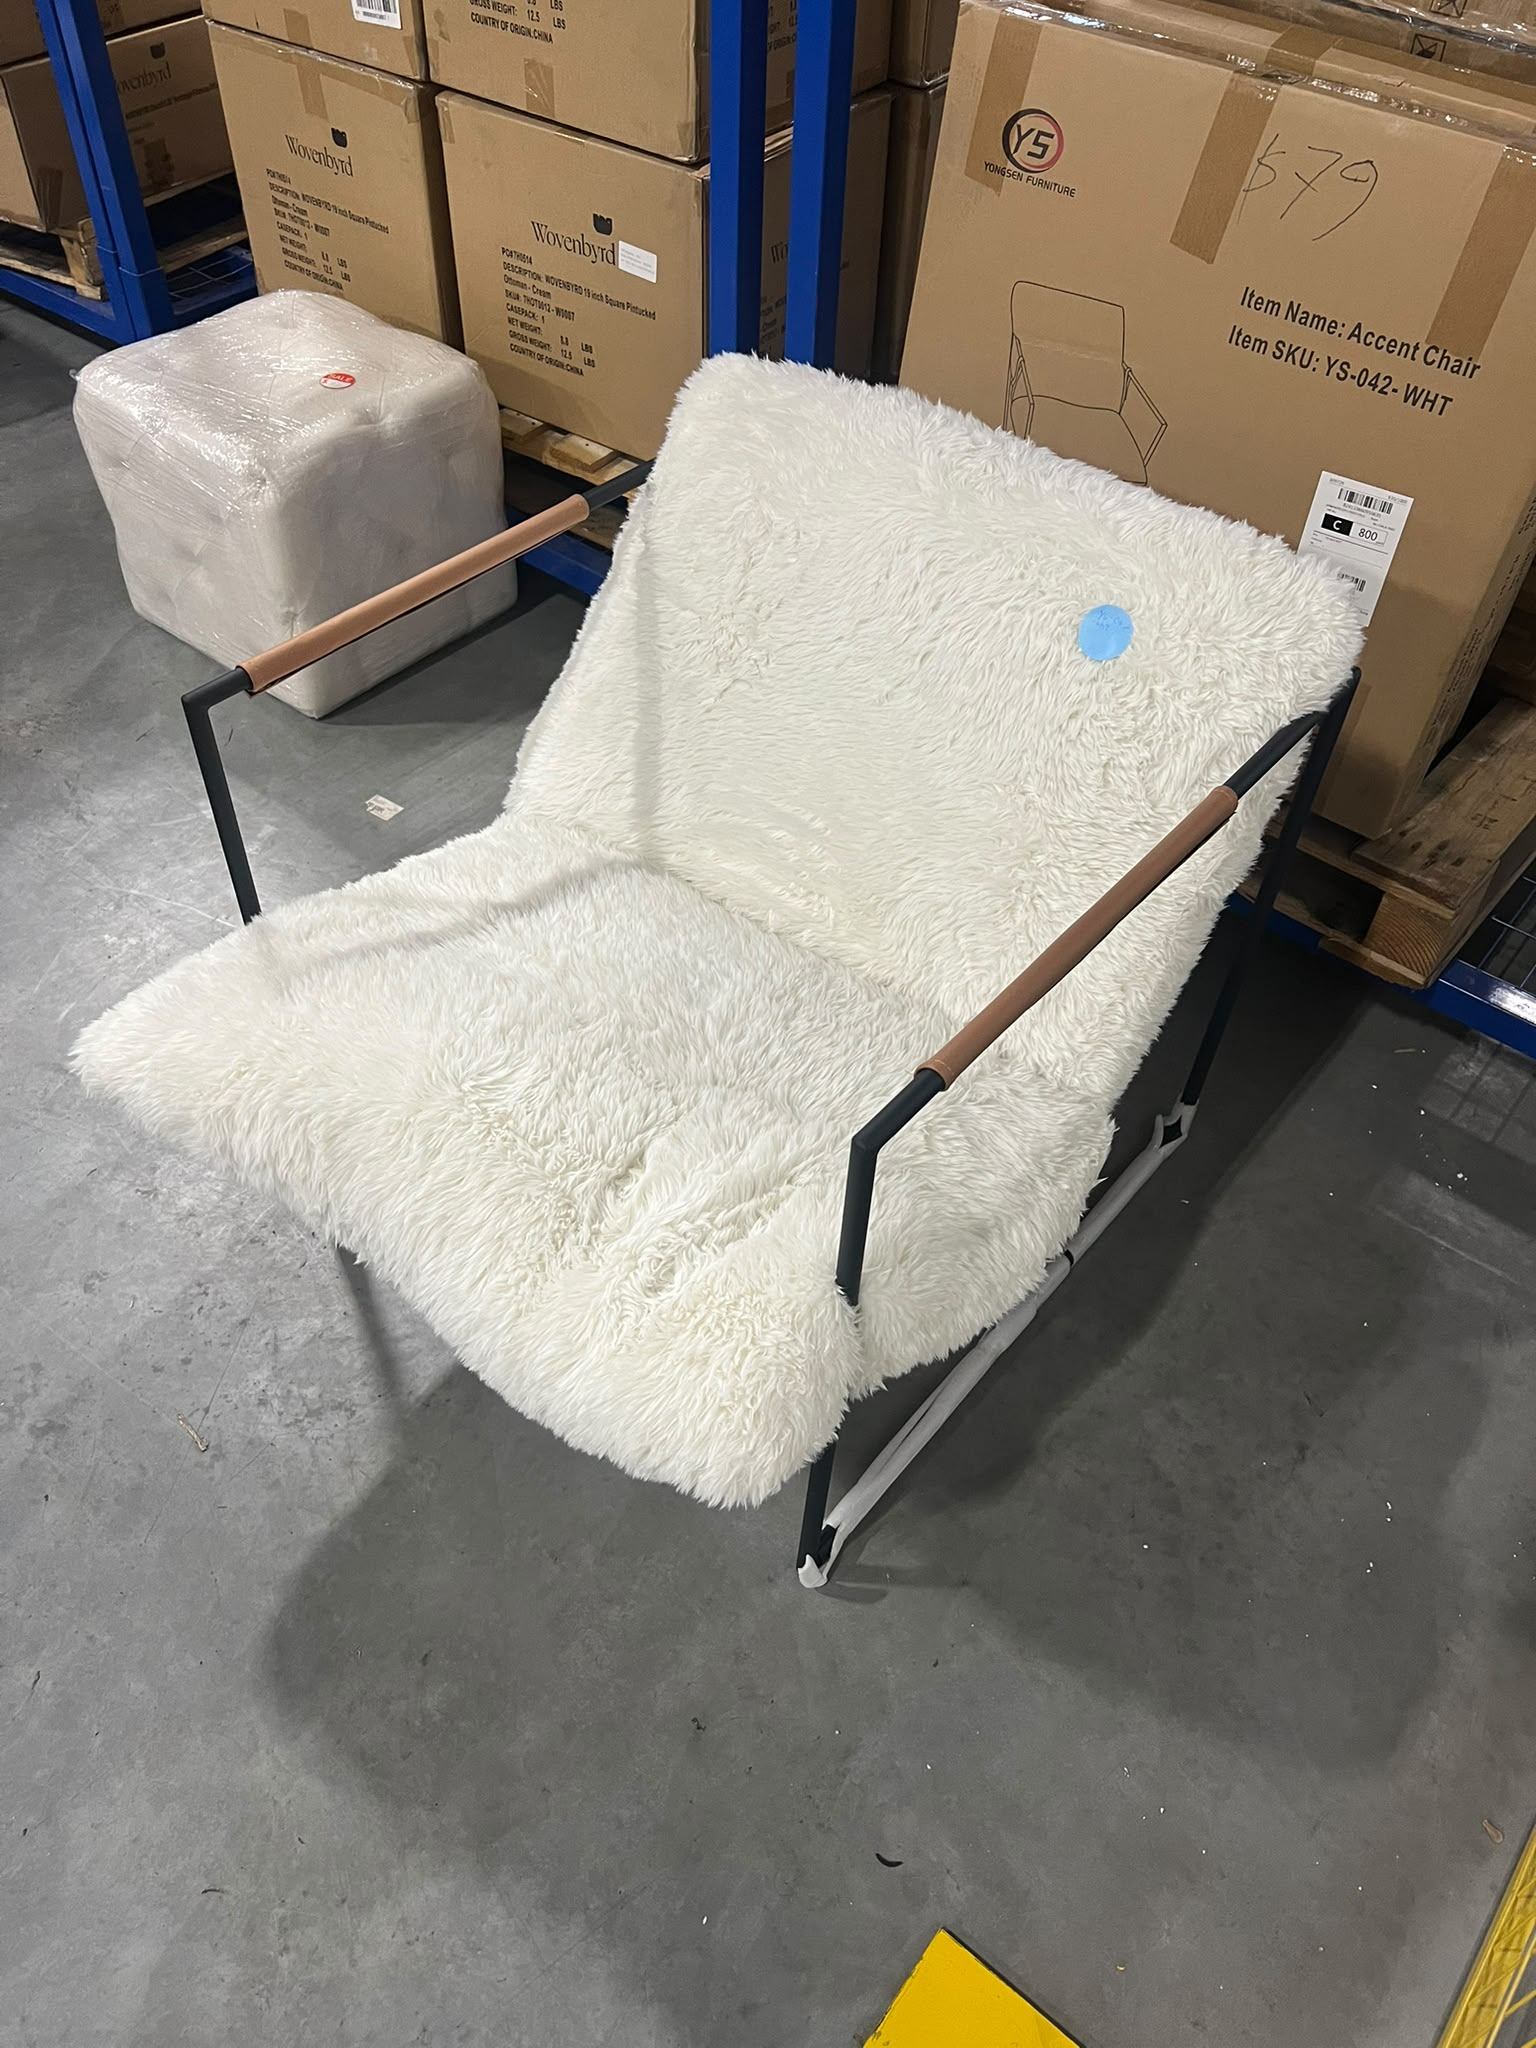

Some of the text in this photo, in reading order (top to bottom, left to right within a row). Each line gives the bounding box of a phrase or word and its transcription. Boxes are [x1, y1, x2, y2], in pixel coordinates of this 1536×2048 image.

[471, 12, 500, 29] COUNTRY
[500, 20, 509, 31] OF
[527, 9, 540, 22] 12.5
[552, 17, 566, 30] LBS
[285, 134, 354, 177] Wovenbyrd
[984, 161, 1077, 198] YONGSEN FURNITURE
[1237, 133, 1379, 242] $79
[530, 220, 616, 266] Wovenbyrd
[532, 284, 552, 300] Cream
[545, 274, 584, 296] WOVENBYRD
[591, 289, 604, 303] inch
[604, 294, 626, 311] Square
[626, 301, 657, 321] Pintucked
[506, 303, 546, 324] CASEPACK: 1
[1240, 286, 1481, 379] Item Name: Accent Chair
[507, 316, 519, 328] NET
[580, 342, 593, 354] LBS
[509, 330, 529, 344] GROSS
[560, 349, 573, 360] 12.5
[583, 357, 596, 368] LBS
[510, 343, 537, 361] COUNTRY
[536, 351, 545, 363] OF
[1228, 325, 1268, 355] Item
[1272, 340, 1320, 372] SKU:
[1332, 519, 1343, 532] C
[1358, 527, 1379, 542] 800
